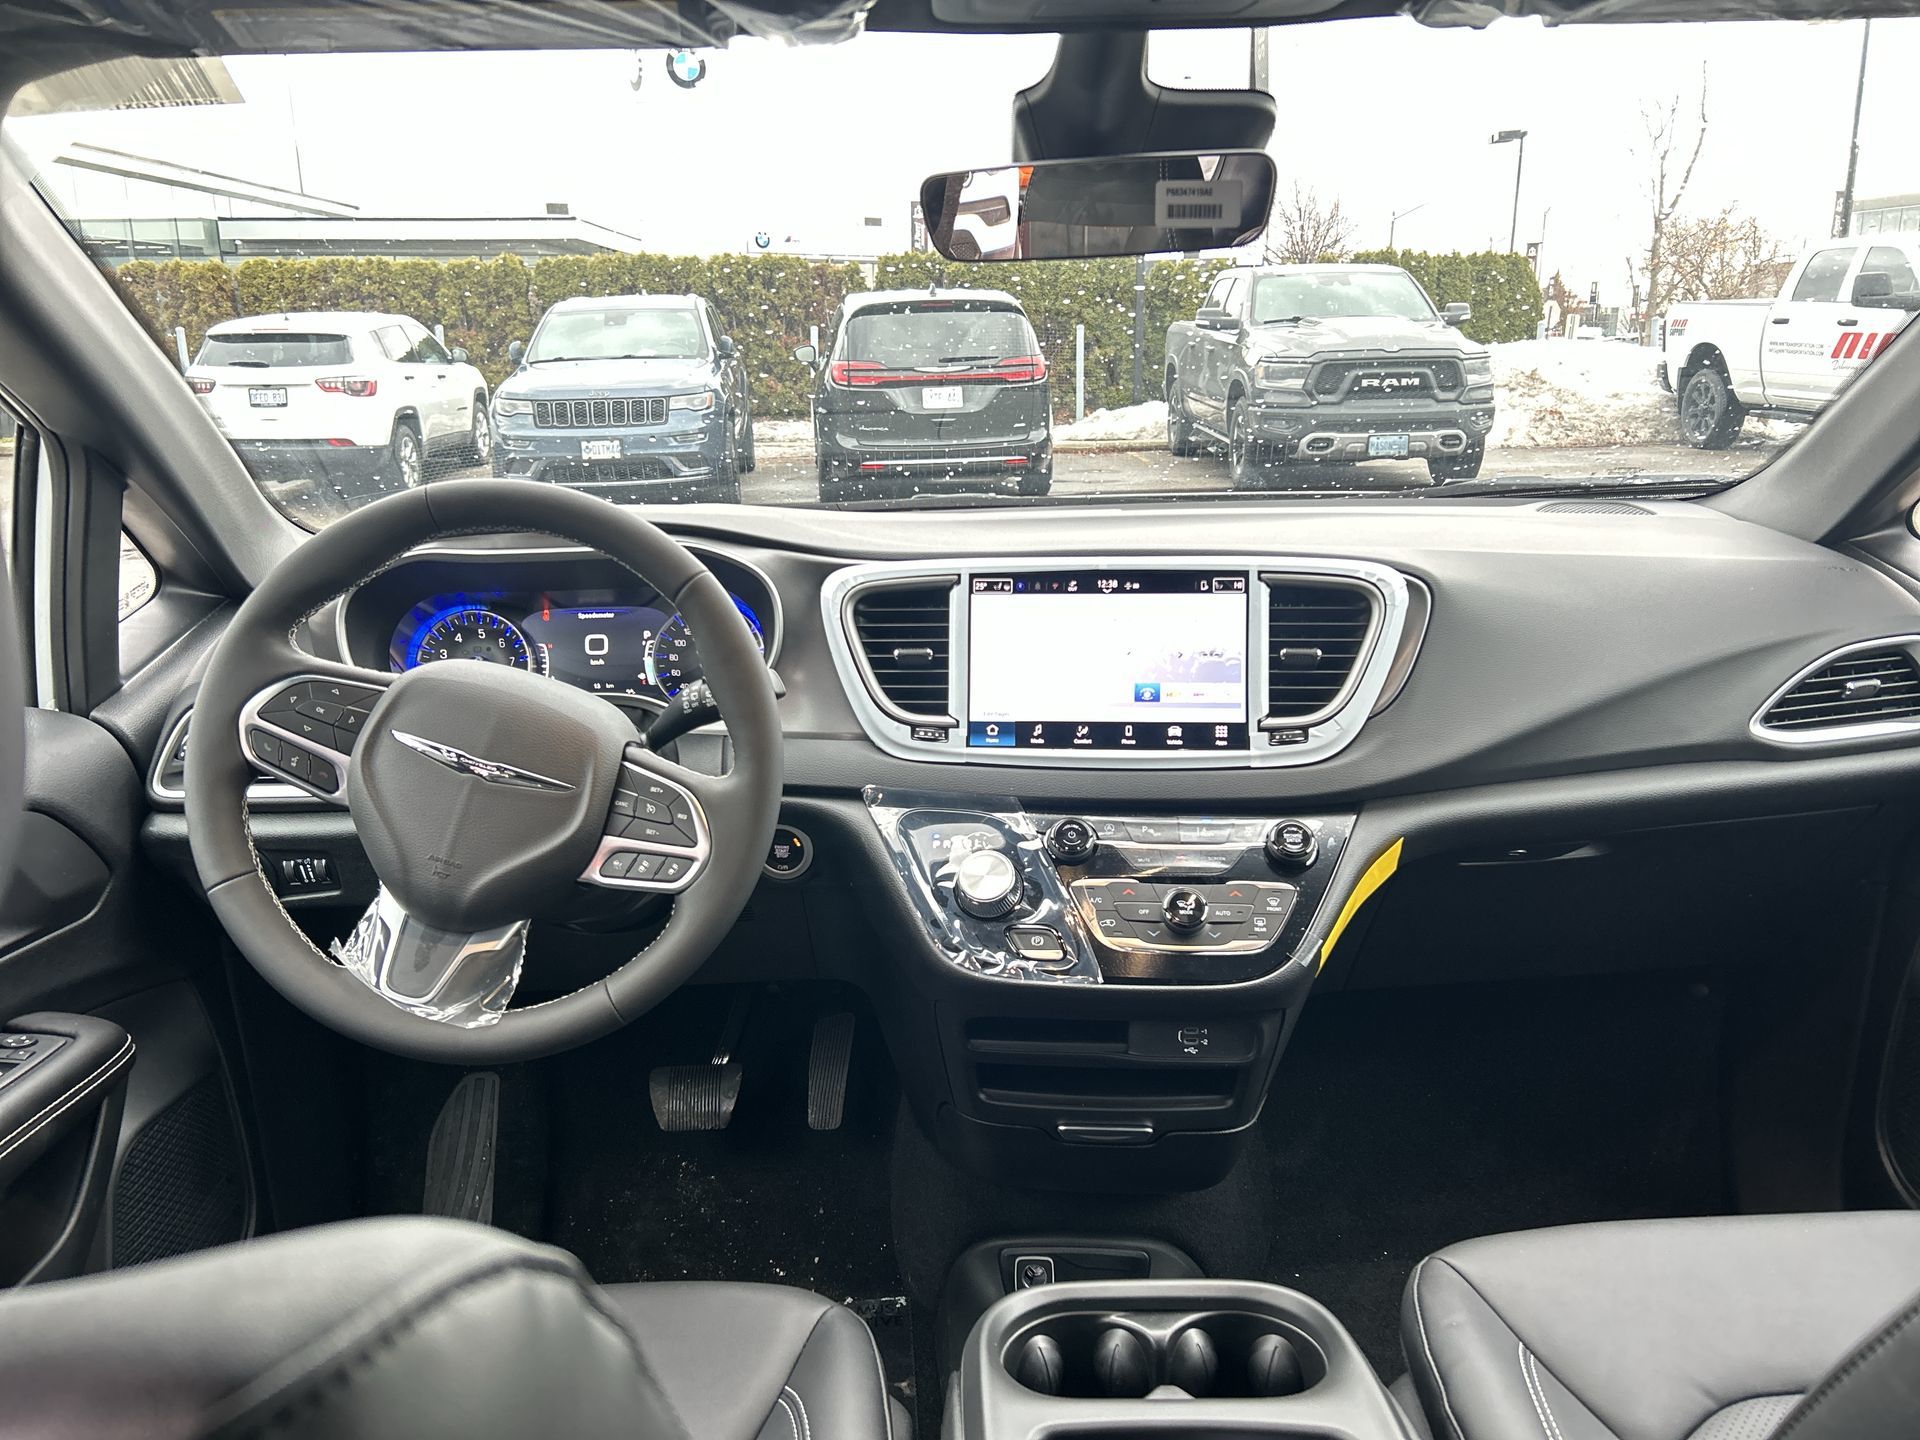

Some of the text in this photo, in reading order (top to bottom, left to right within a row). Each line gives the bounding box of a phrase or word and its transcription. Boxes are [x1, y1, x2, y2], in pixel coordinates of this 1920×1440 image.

[1361, 378, 1420, 387] RAM
[455, 632, 463, 643] 4
[478, 628, 486, 639] 5
[498, 638, 506, 648] 6
[585, 634, 609, 656] 0
[439, 649, 448, 659] 3
[509, 657, 515, 667] 7
[315, 706, 326, 714] OK
[677, 812, 688, 820] RES
